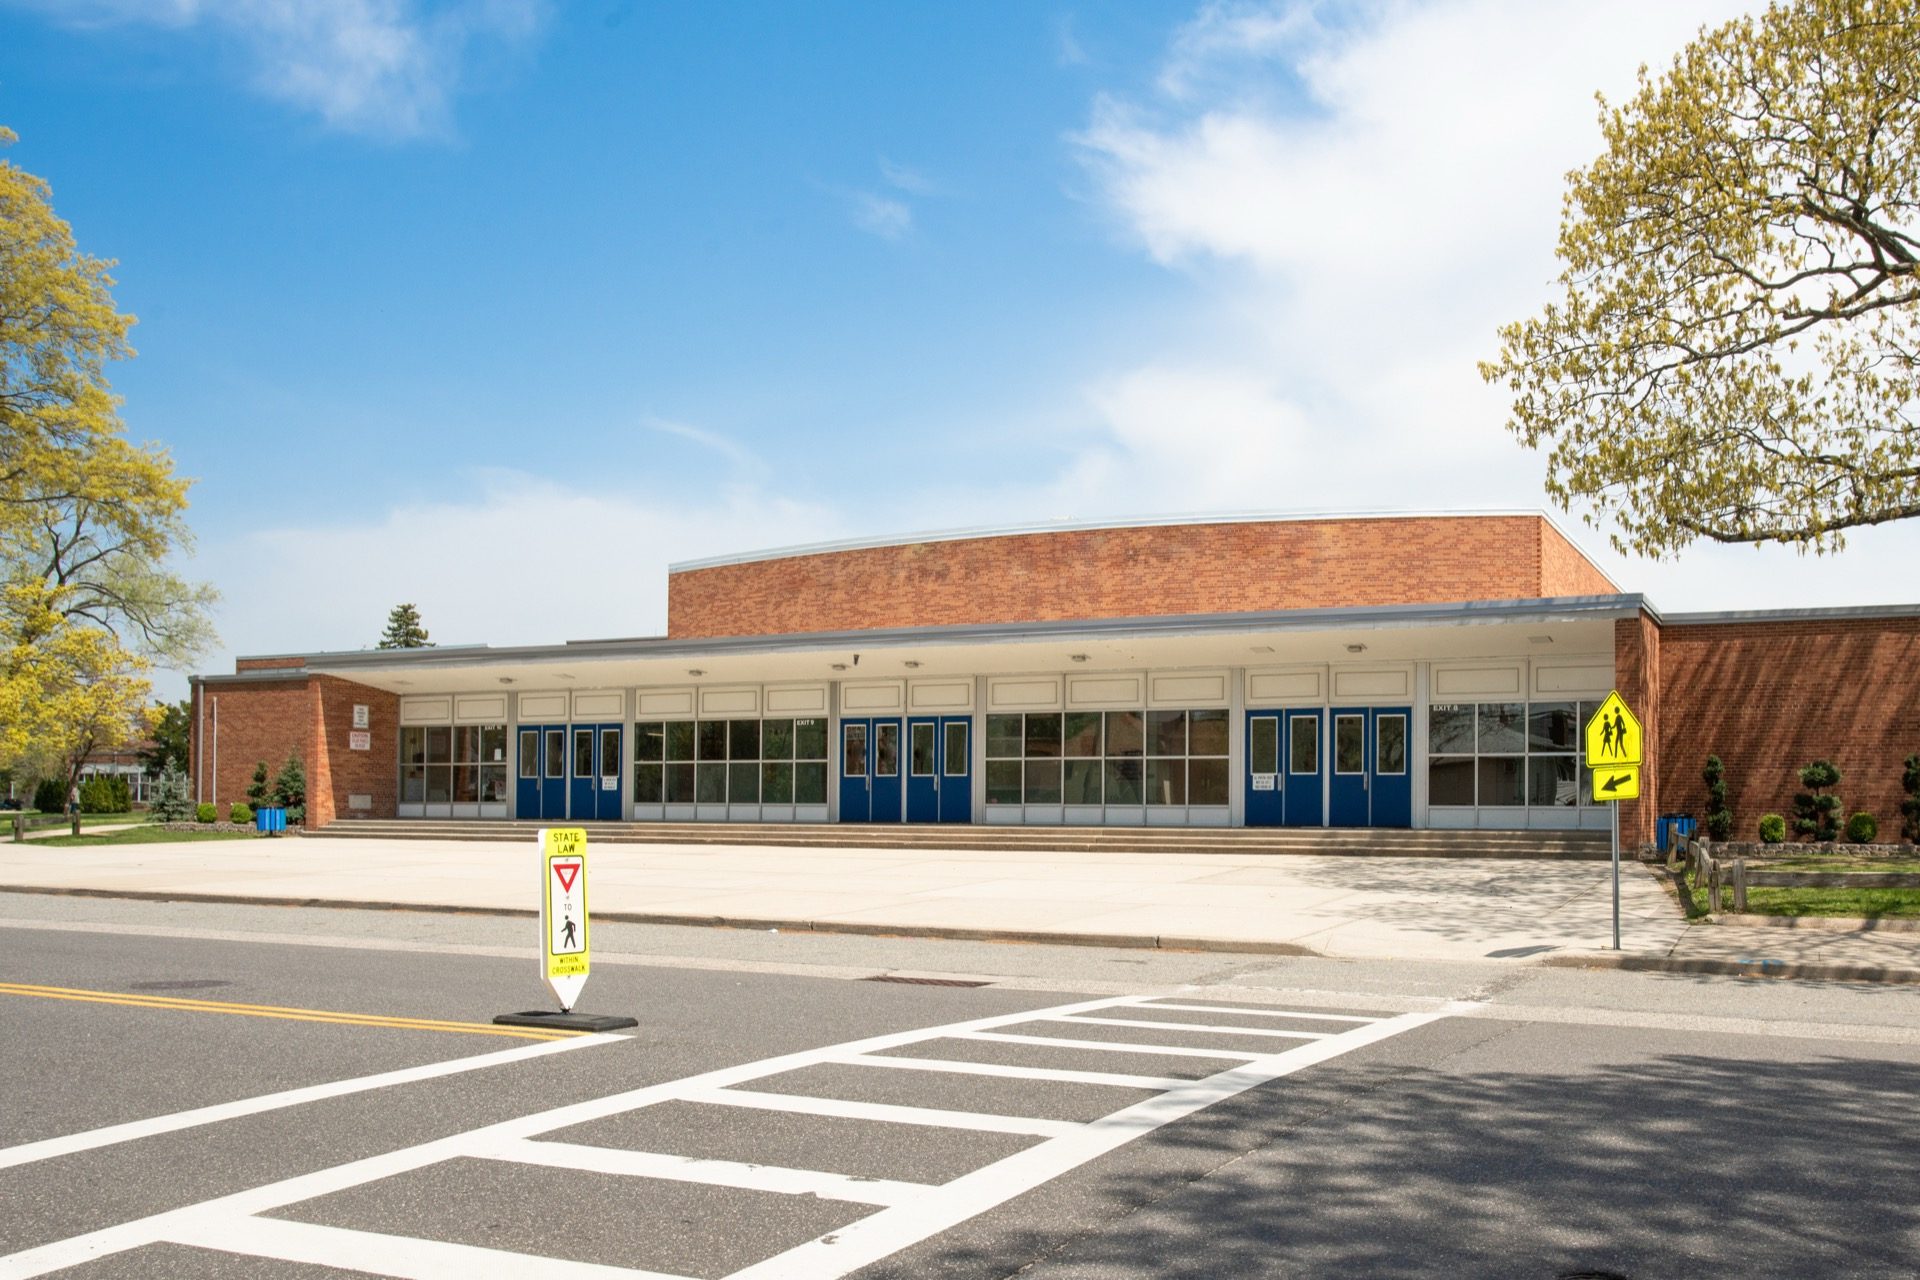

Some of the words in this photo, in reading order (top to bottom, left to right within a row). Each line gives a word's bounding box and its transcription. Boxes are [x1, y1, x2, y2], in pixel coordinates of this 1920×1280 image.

[553, 832, 580, 842] STATE
[557, 844, 575, 854] LAW
[564, 903, 572, 911] TO
[559, 956, 579, 964] WITHIN
[551, 965, 586, 975] CROSSWALK
